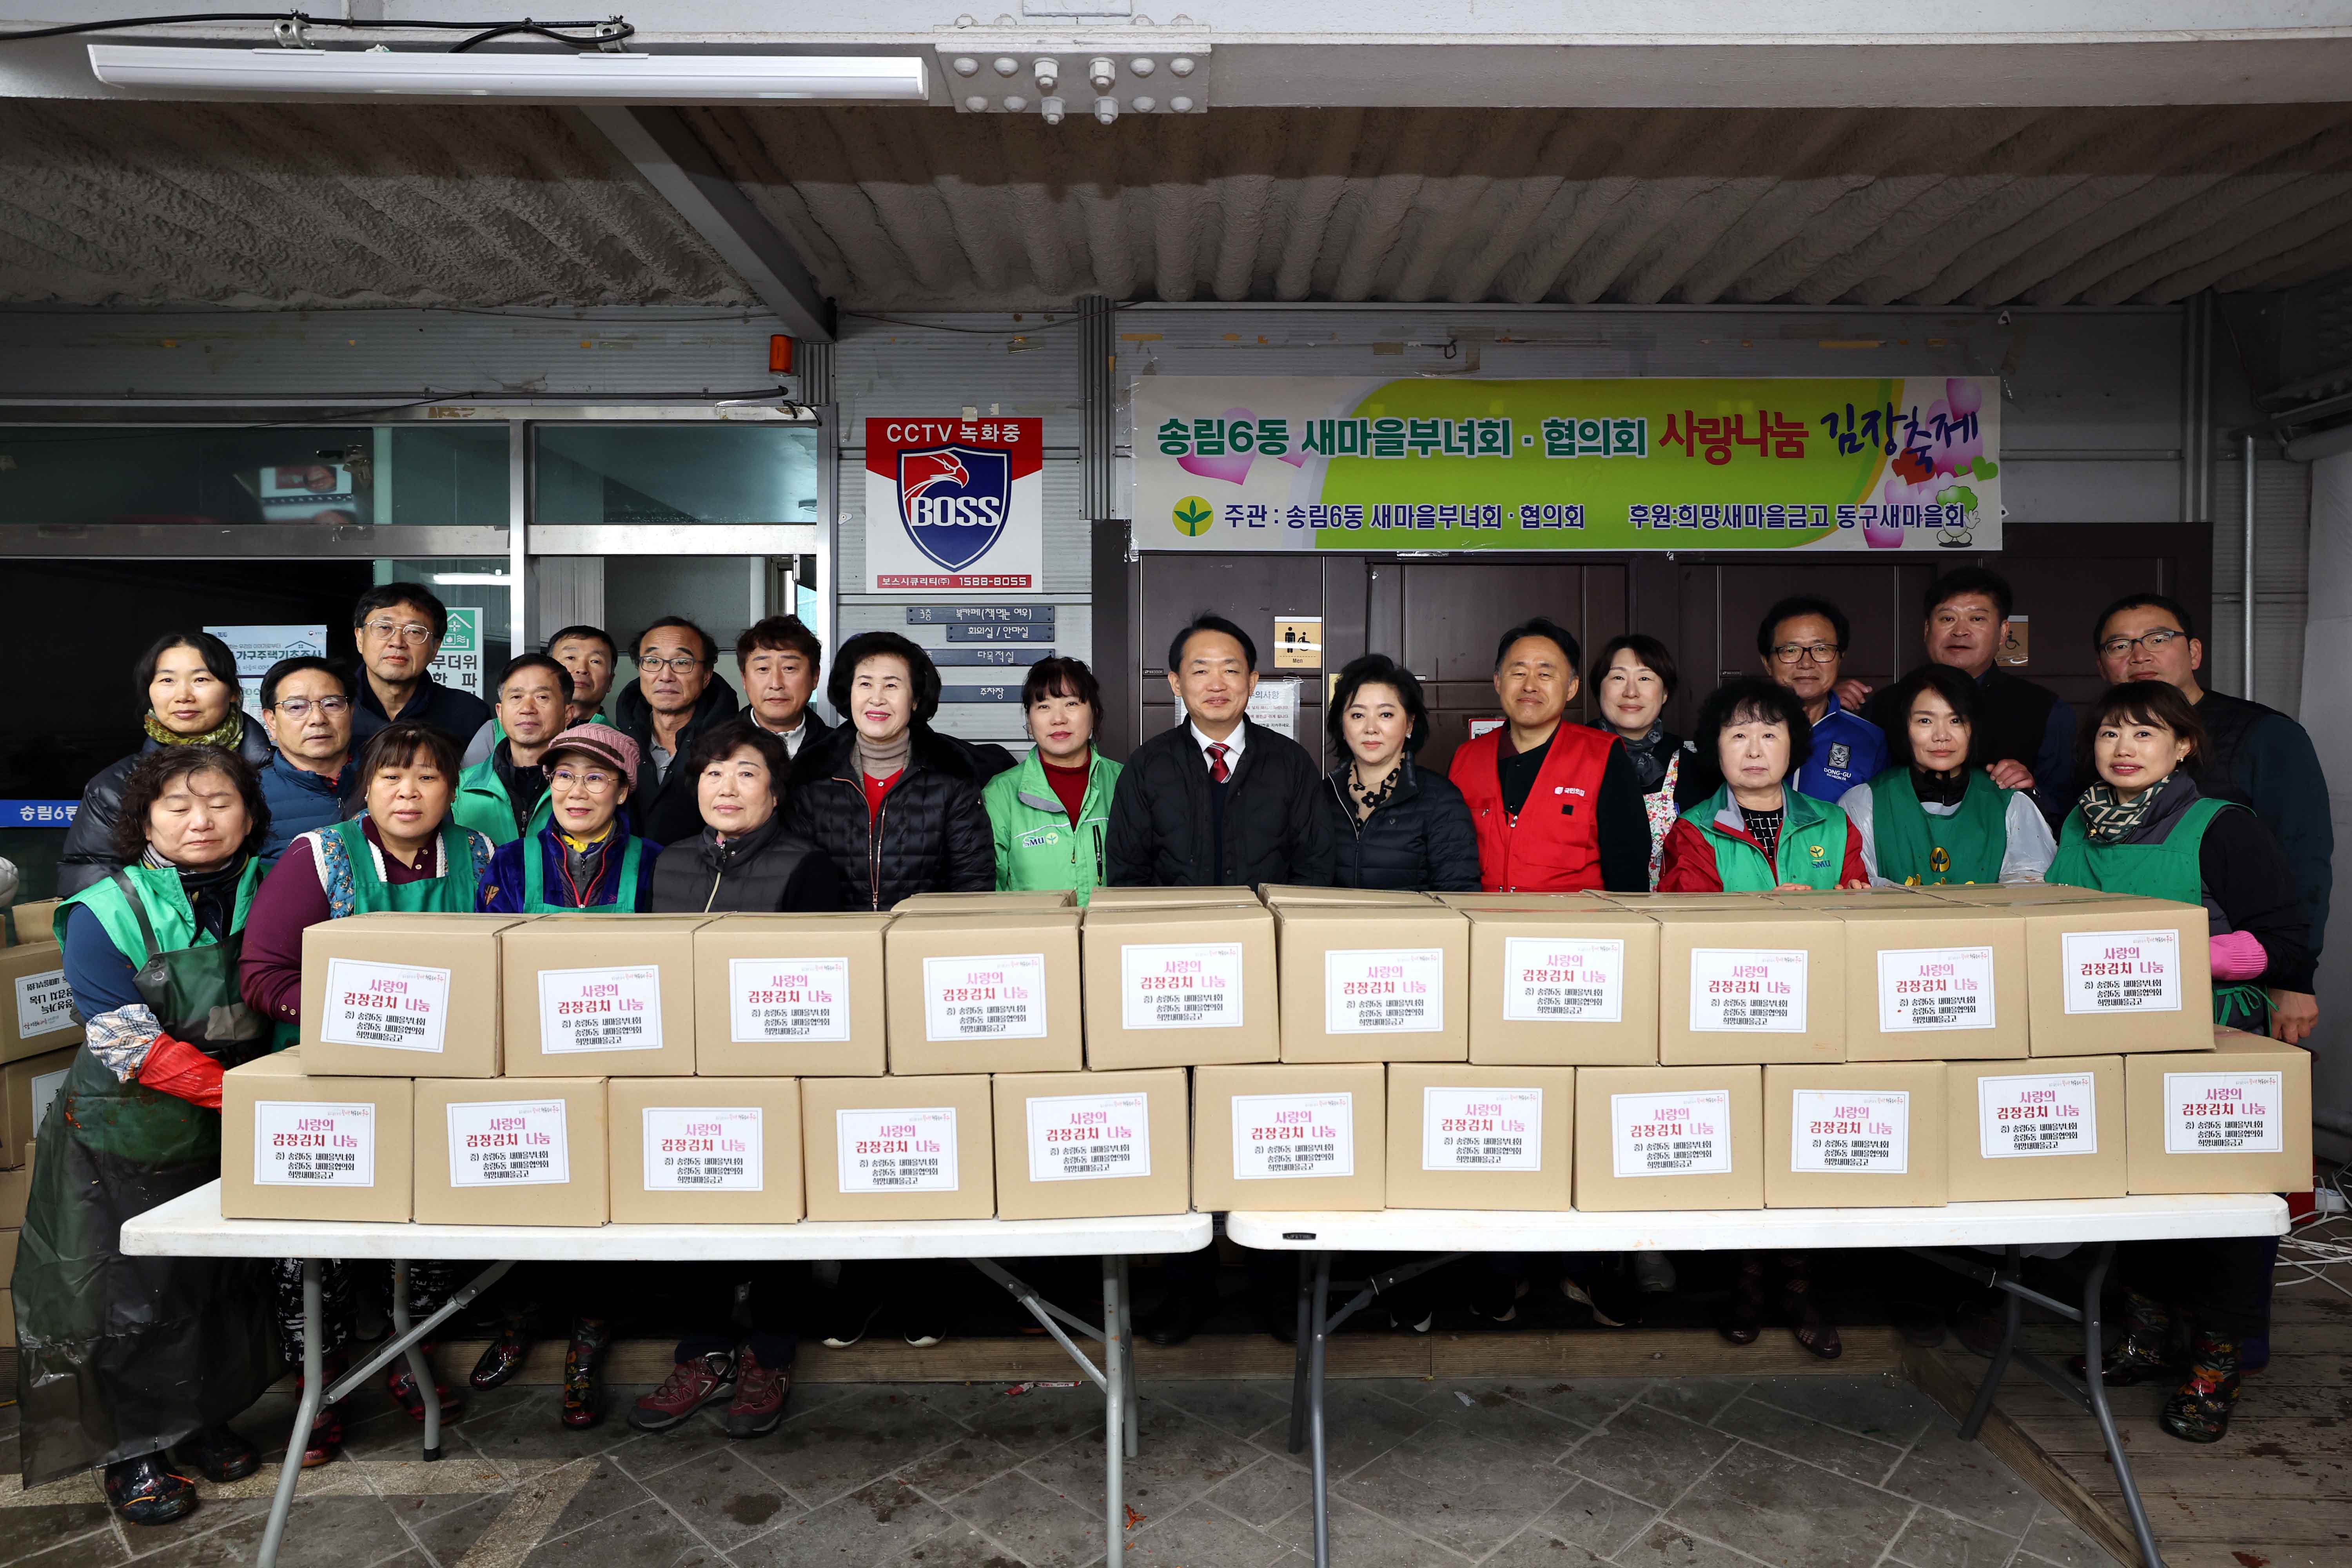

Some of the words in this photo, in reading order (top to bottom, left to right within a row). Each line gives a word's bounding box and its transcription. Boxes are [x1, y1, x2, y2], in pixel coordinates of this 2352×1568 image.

[887, 424, 953, 442] CCTV
[960, 424, 1020, 442] 녹화중
[1157, 418, 1290, 456] 송림6동
[1659, 410, 1809, 465] 사랑나눔
[1820, 403, 1978, 473] 김장축제
[911, 496, 1000, 526] BOSS
[1286, 505, 1363, 528] 송림6동
[1836, 504, 1964, 528] 동구새마을회
[882, 577, 949, 586] 보스시큐리티(주)
[959, 577, 1026, 586] 1588-8055
[920, 609, 931, 621] 3층
[968, 627, 993, 639] 회의실
[1003, 627, 1028, 638] 안마실
[432, 655, 477, 670] 무더위
[978, 651, 1014, 663] 다목적실
[980, 688, 1004, 699] 주차장
[1824, 768, 1851, 778] DONG-GU
[2103, 947, 2140, 959] 사랑의
[1165, 960, 1201, 973] 사랑의
[1547, 955, 1583, 967] 사랑의
[1367, 966, 1403, 978] 사랑의
[1732, 966, 1768, 978] 사랑의
[1918, 964, 1954, 976] 사랑의
[2081, 962, 2132, 975] 김장김치
[2140, 962, 2164, 973] 나눔
[771, 975, 808, 987] 사랑의
[967, 972, 1004, 984] 사랑의
[1141, 976, 1192, 989] 김장김치
[1201, 975, 1226, 987] 나눔
[1523, 969, 1573, 982] 김장김치
[1583, 970, 1606, 983] 나눔
[369, 979, 407, 994] 사랑의
[1344, 982, 1394, 994] 김장김치
[1403, 981, 1426, 993] 나눔
[1709, 981, 1759, 993] 김장김치
[1768, 982, 1791, 994] 나눔
[1896, 979, 1946, 993] 김장김치
[1955, 978, 1978, 990] 나눔
[2123, 979, 2161, 987] 새마을부녀회
[50, 988, 72, 1001] 장김치
[581, 984, 618, 997] 사랑의
[749, 991, 799, 1003] 김장김치
[808, 990, 832, 1002] 나눔
[943, 988, 995, 1001] 김장김치
[1004, 987, 1028, 998] 나눔
[29, 995, 46, 1004] 나눔
[344, 993, 397, 1009] 김장김치
[405, 998, 430, 1012] 나눔
[558, 1000, 610, 1014] 김장김치
[619, 998, 644, 1011] 나눔
[358, 1013, 381, 1022] 송림6동
[386, 1015, 425, 1025] 새마을부녀회
[357, 1022, 380, 1031] 송림6동
[385, 1025, 424, 1035] 새마을협의회
[356, 1031, 402, 1041] 희망새마을금고
[2020, 1091, 2055, 1103] 사랑의
[2205, 1088, 2241, 1100] 사랑의
[1465, 1104, 1501, 1116] 사랑의
[1653, 1108, 1690, 1120] 사랑의
[1833, 1107, 1869, 1119] 사랑의
[1997, 1106, 2047, 1120] 김장김치
[2056, 1105, 2079, 1116] 나눔
[2183, 1103, 2233, 1115] 김장김치
[2242, 1103, 2266, 1114] 나눔
[1069, 1111, 1107, 1124] 사랑의
[1275, 1111, 1312, 1123] 사랑의
[297, 1119, 334, 1131] 사랑의
[489, 1118, 525, 1130] 사랑의
[685, 1124, 721, 1136] 사랑의
[1442, 1119, 1492, 1131] 김장김치
[1501, 1120, 1525, 1132] 나눔
[1631, 1124, 1681, 1138] 김장김치
[1690, 1123, 1714, 1134] 나눔
[1810, 1122, 1860, 1134] 김장김치
[1869, 1123, 1892, 1135] 나눔
[879, 1125, 916, 1137] 사랑의
[1047, 1127, 1098, 1142] 김장김치
[1107, 1126, 1131, 1138] 나눔
[1252, 1127, 1303, 1140] 김장김치
[1312, 1126, 1336, 1138] 나눔
[273, 1134, 325, 1147] 김장김치
[334, 1135, 358, 1147] 나눔
[466, 1133, 517, 1147] 김장김치
[526, 1132, 550, 1145] 나눔
[662, 1139, 713, 1151] 김장김치
[722, 1139, 745, 1151] 나눔
[856, 1141, 907, 1153] 김장김치
[916, 1140, 940, 1152] 나눔
